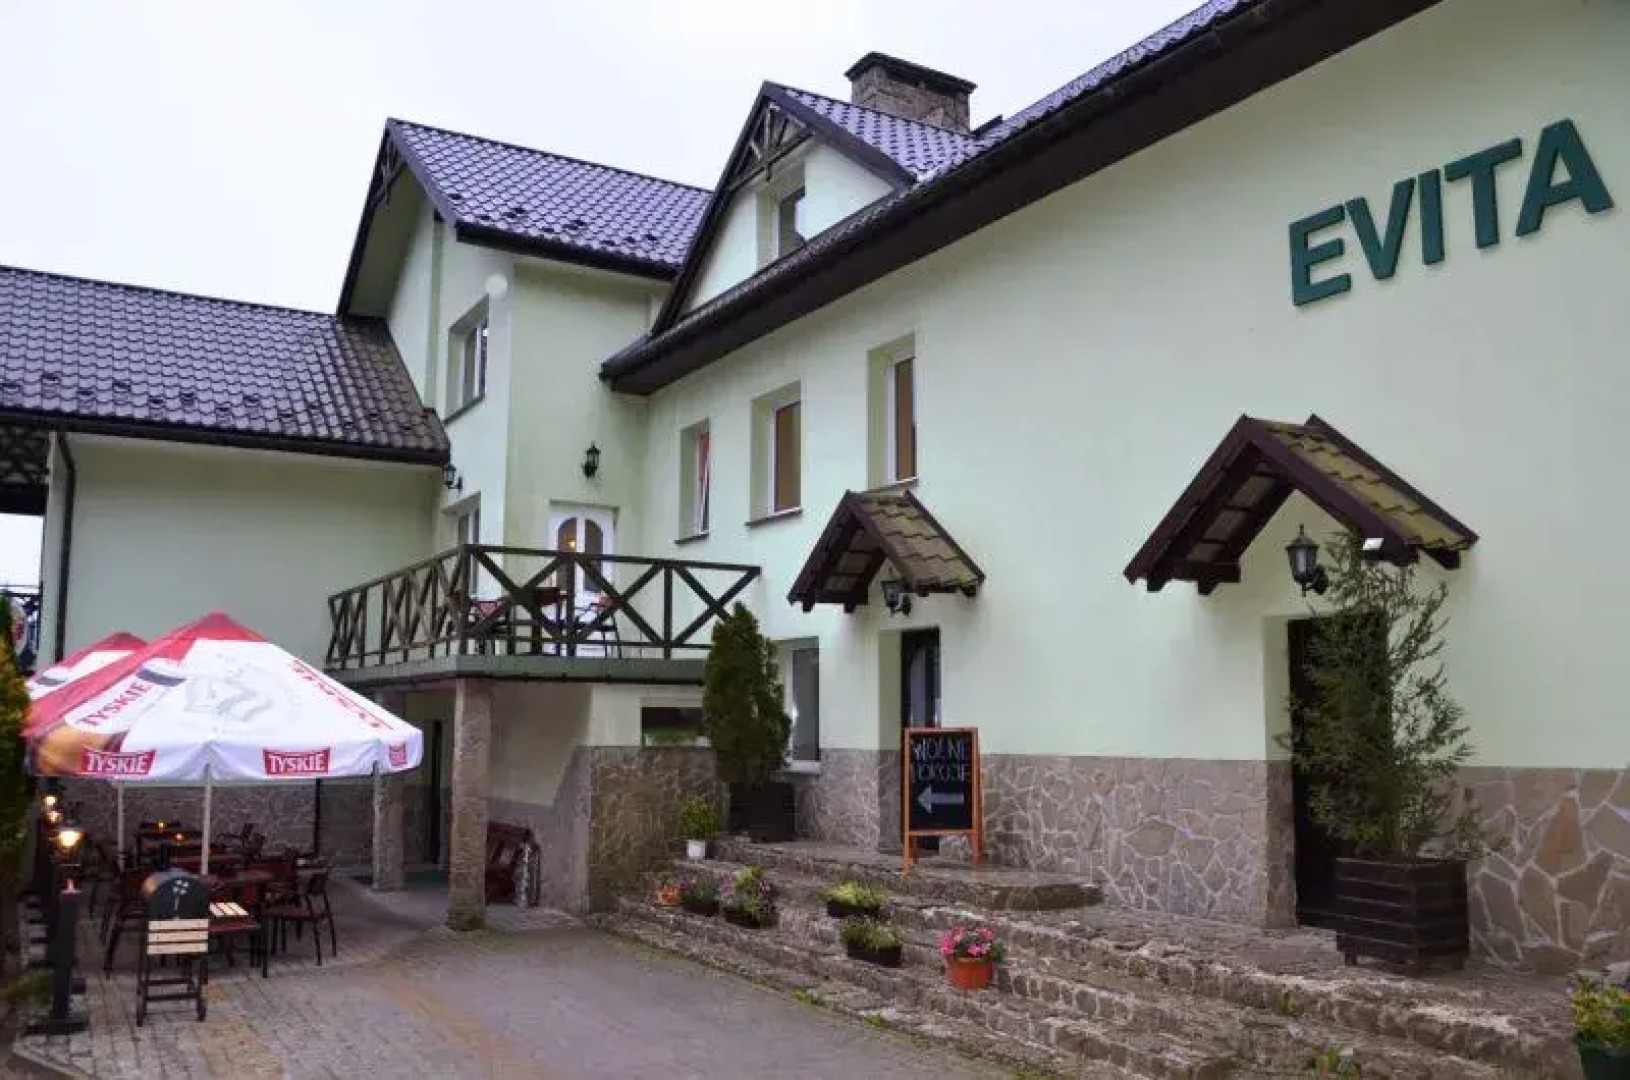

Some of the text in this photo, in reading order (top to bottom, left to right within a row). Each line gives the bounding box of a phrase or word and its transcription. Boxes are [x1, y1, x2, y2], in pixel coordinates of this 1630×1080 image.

[1289, 118, 1614, 306] EVITA
[78, 683, 153, 726] TYSKIE
[86, 752, 148, 773] TYSKIE
[268, 752, 325, 773] TYSKIE
